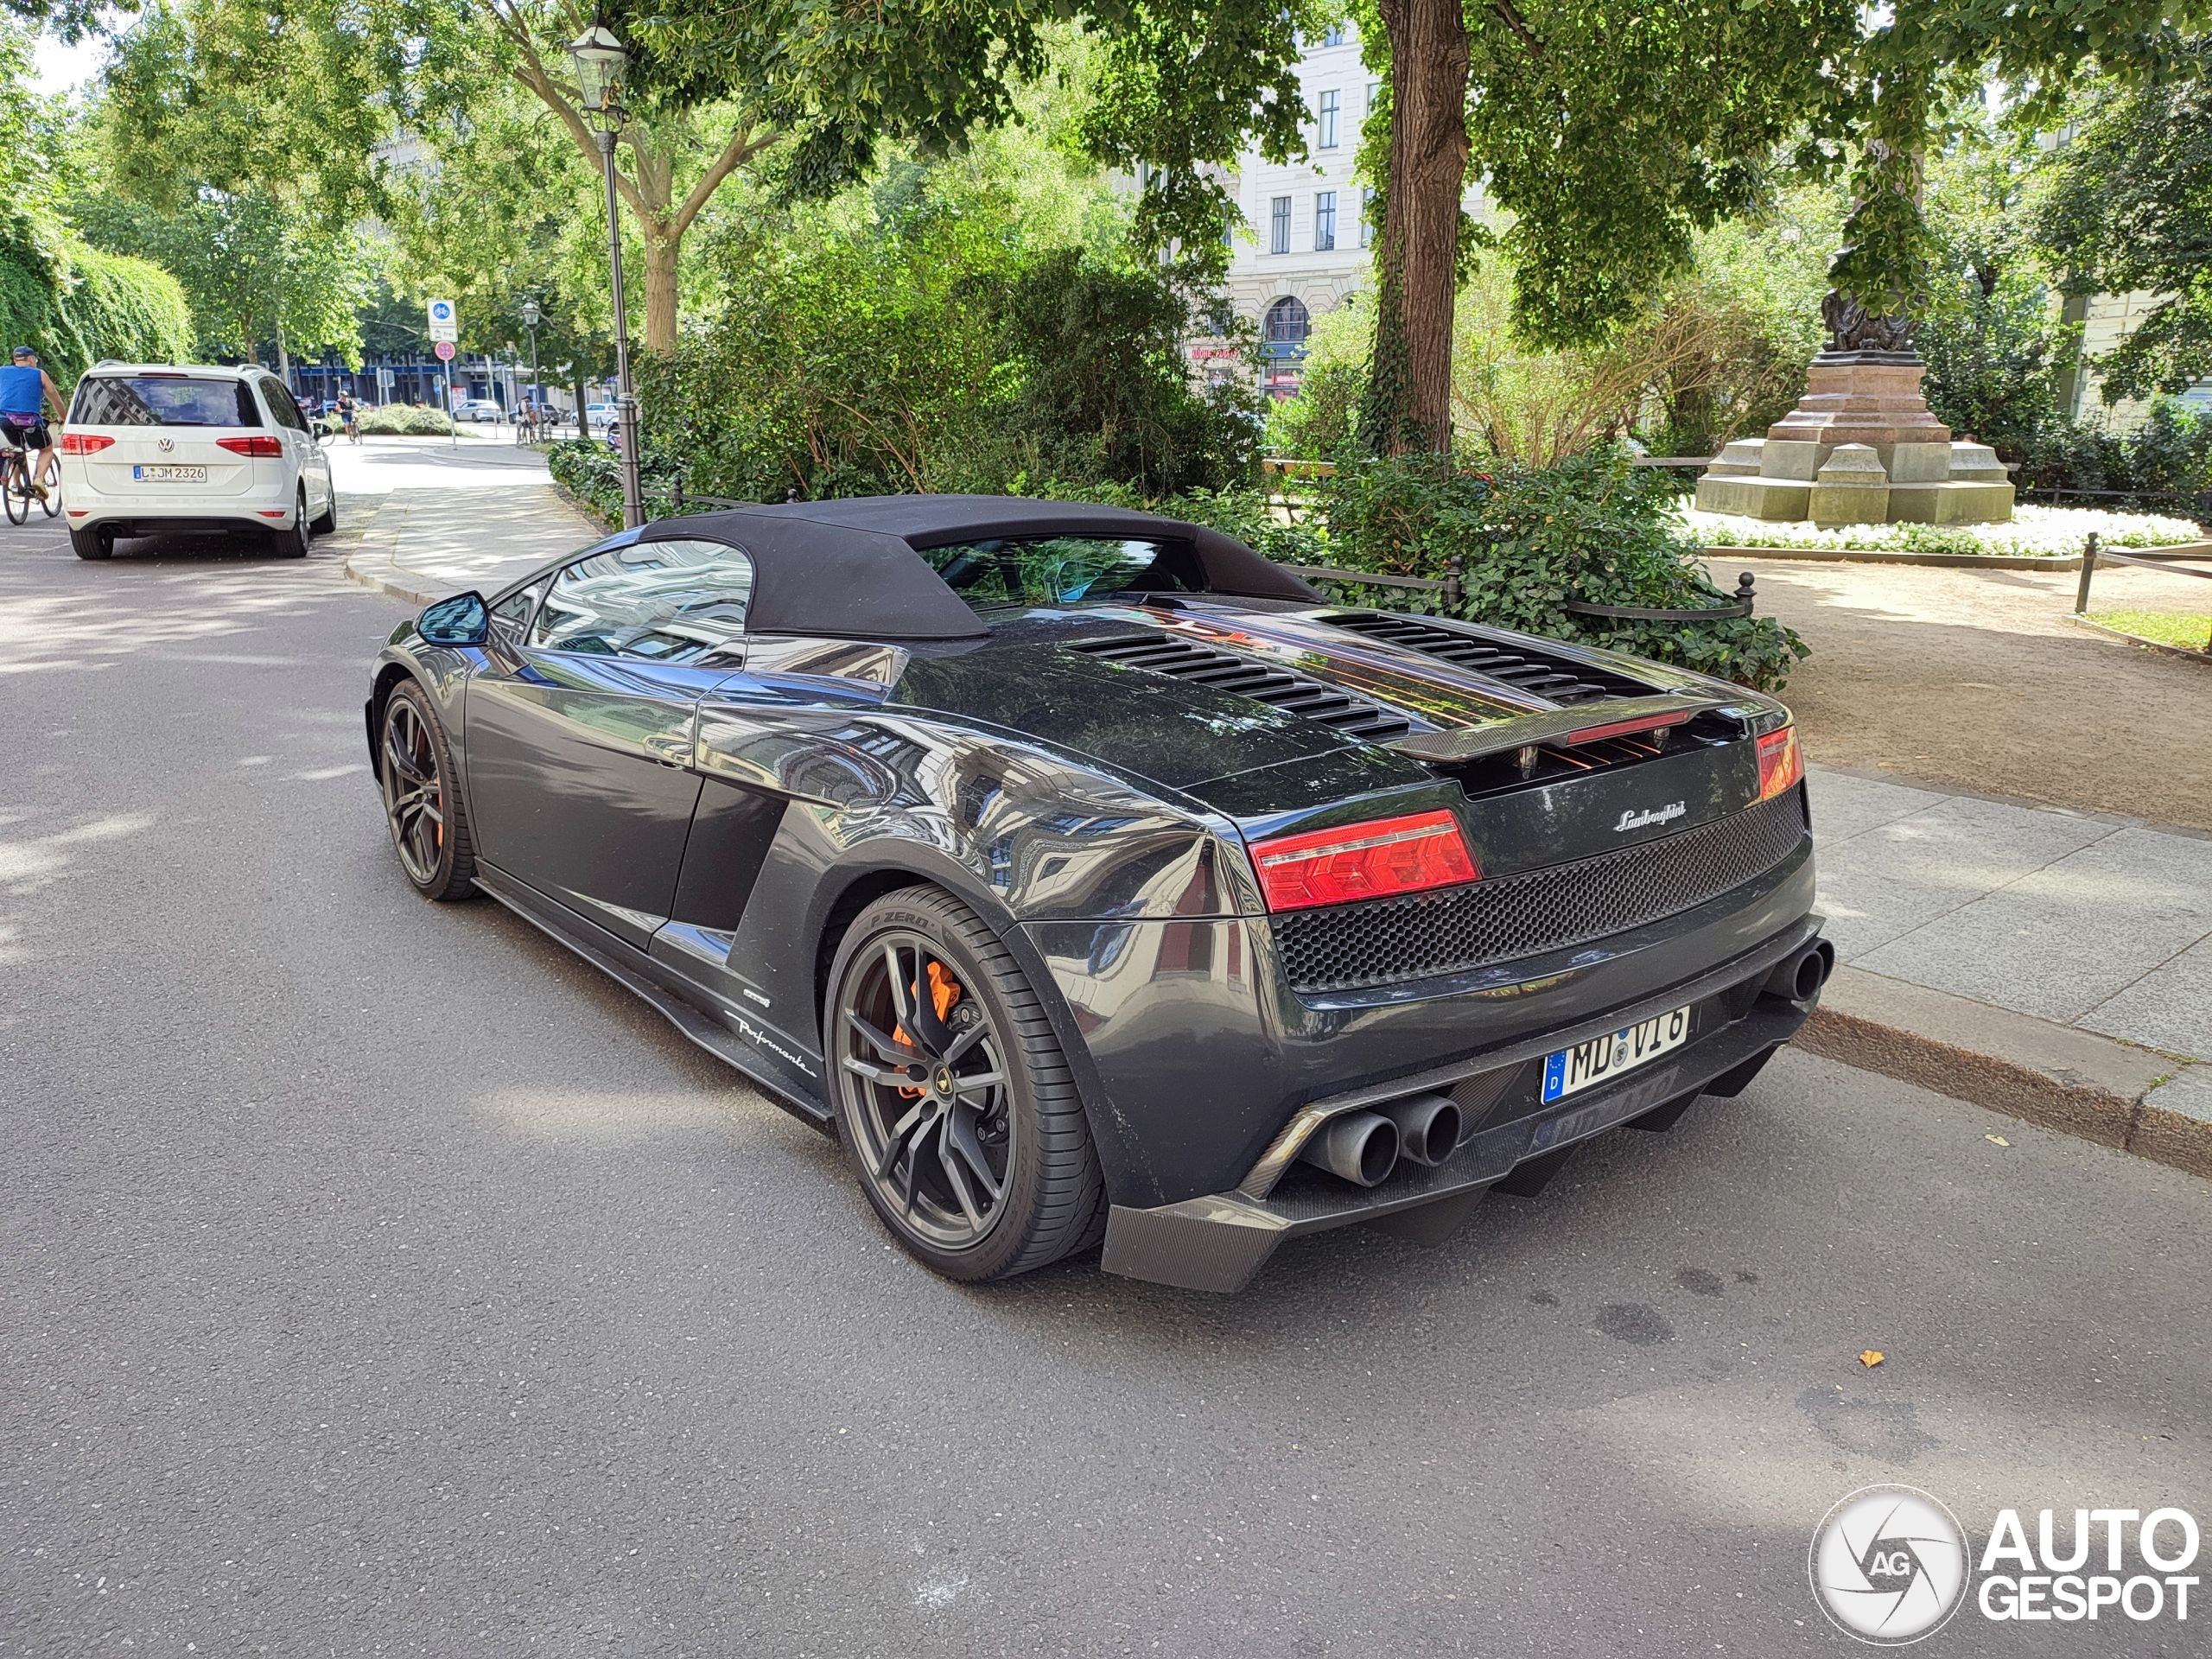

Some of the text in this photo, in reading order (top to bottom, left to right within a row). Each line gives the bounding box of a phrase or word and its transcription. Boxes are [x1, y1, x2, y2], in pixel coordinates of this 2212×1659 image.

[142, 467, 149, 478] L
[157, 467, 173, 478] JM
[175, 467, 204, 478] 2326
[1613, 801, 1686, 831] Lamborghini
[871, 912, 929, 928] P ZERO
[724, 1010, 817, 1077] Performante
[1550, 1076, 1559, 1090] D
